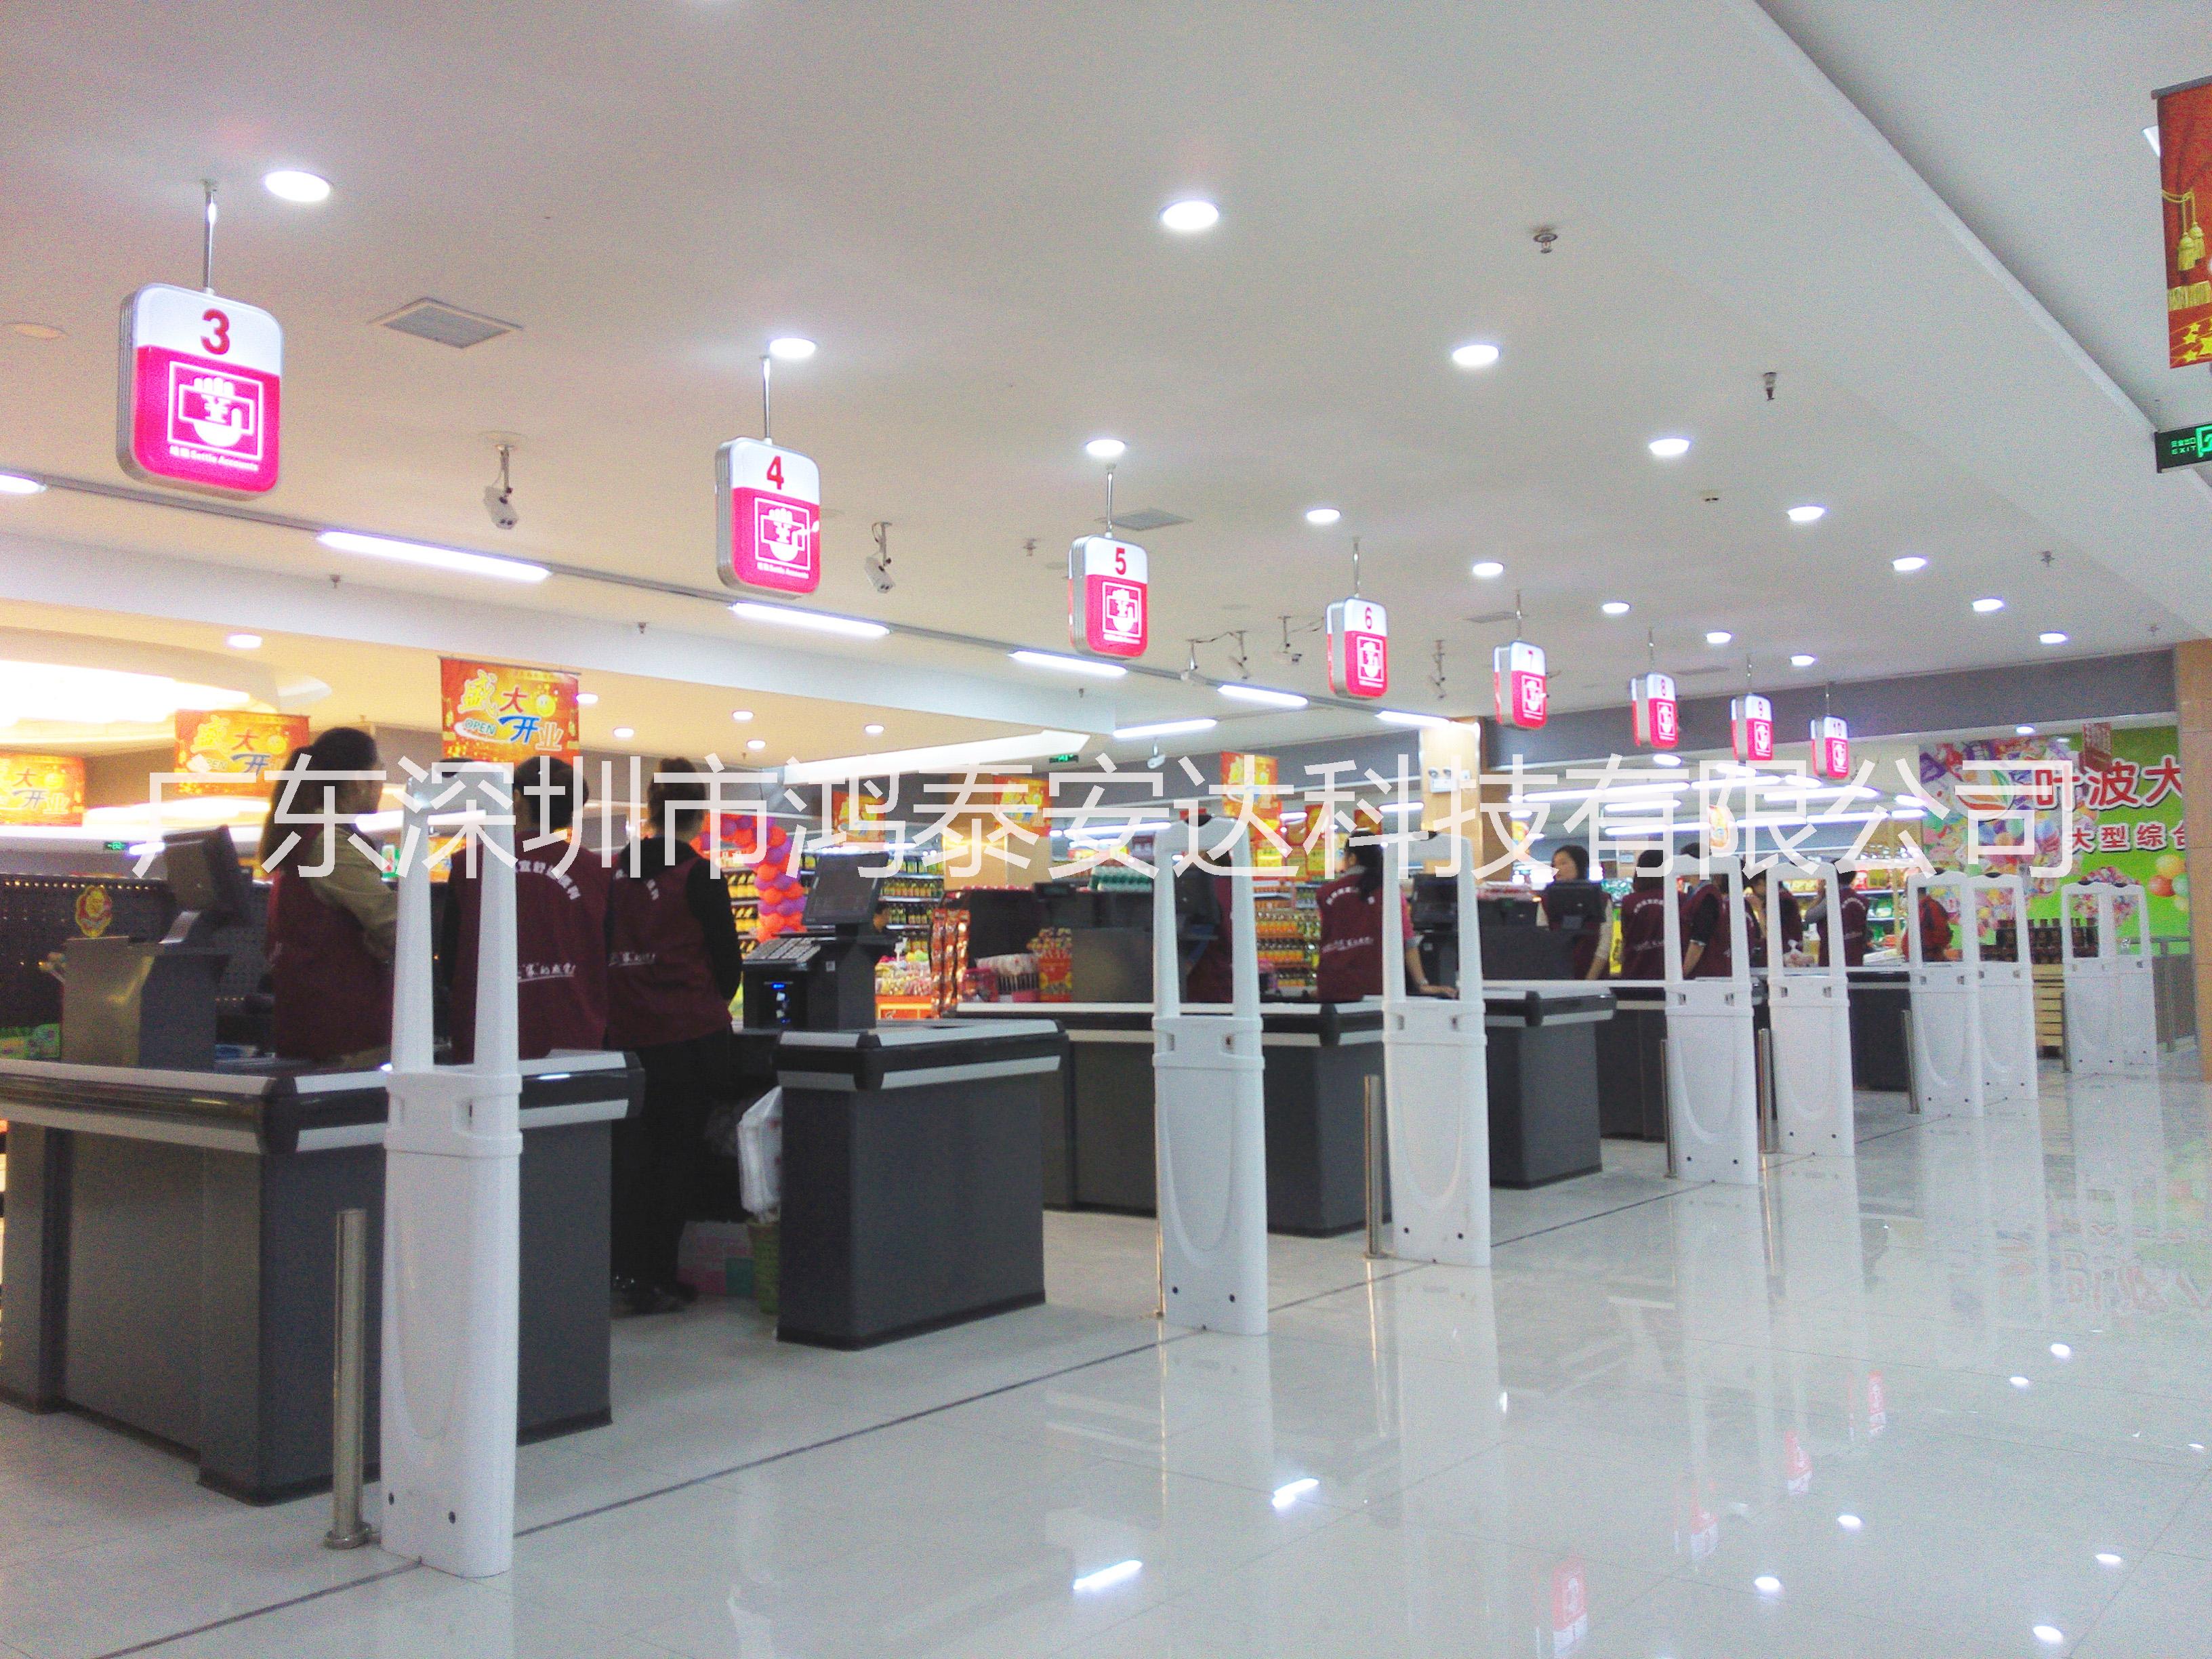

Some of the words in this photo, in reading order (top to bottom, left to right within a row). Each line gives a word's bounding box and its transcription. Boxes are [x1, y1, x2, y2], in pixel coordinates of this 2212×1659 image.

[200, 308, 230, 355] 3
[2171, 445, 2196, 455] EXIT
[766, 455, 784, 490] 4
[1115, 548, 1126, 575] 5
[1364, 607, 1372, 629] 6
[464, 718, 497, 735] OPEN
[498, 715, 564, 751] 开业
[2034, 756, 2183, 808] 叶波大
